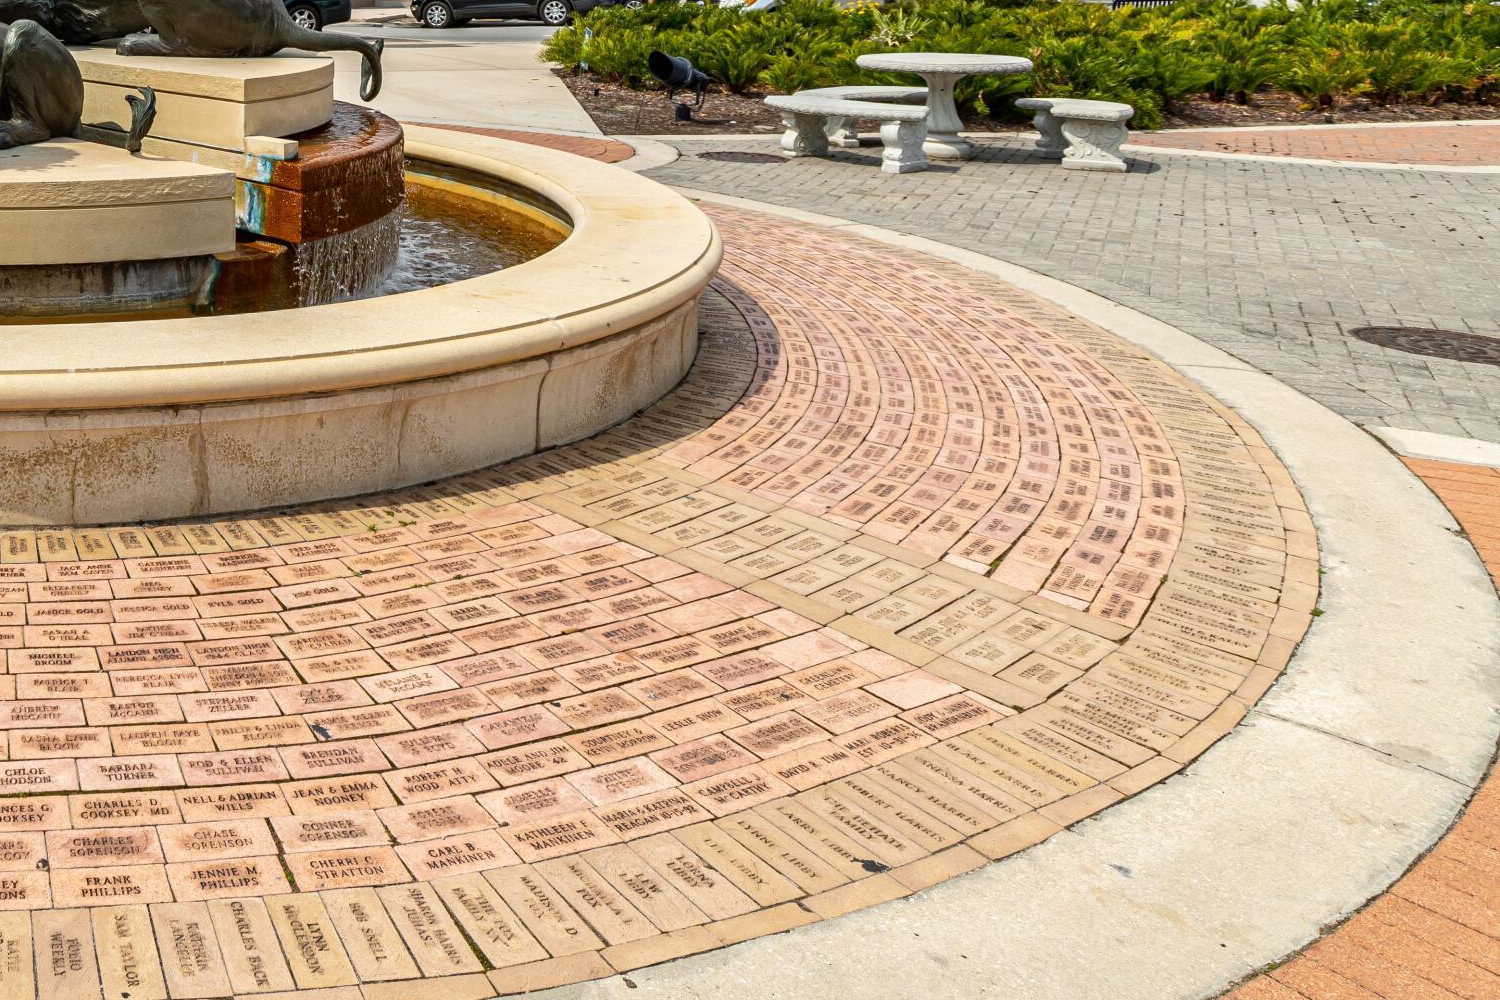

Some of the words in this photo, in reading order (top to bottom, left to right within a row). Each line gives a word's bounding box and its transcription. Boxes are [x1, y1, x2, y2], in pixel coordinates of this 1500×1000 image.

[662, 717, 697, 732] LESLIE
[696, 708, 724, 722] SNOW
[4, 767, 45, 777] CHLOE
[101, 762, 156, 773] BARBARA
[778, 763, 809, 779] DAVID
[820, 751, 850, 765] TIMM
[946, 742, 987, 767] BLAKE
[992, 768, 1045, 798] HARRIS
[0, 775, 51, 786] HODSON
[105, 771, 156, 781] TURNER
[292, 786, 324, 799] JEAN
[328, 785, 337, 794] &
[340, 781, 379, 794] EMMA
[182, 794, 216, 805] NELL
[218, 794, 227, 803] &
[229, 790, 277, 802] ADRIAN
[314, 792, 366, 806] NOONEY
[215, 802, 254, 812] WILLS
[844, 780, 893, 810] ROBERT
[896, 812, 946, 844] HARRIS
[194, 828, 238, 840] CHASE
[514, 821, 578, 844] KATHLEEN
[184, 837, 253, 851] SORENSON
[529, 829, 595, 851] MANKINEN
[428, 844, 462, 859] CARL
[309, 856, 360, 869] CHERRI
[425, 850, 496, 872] MANKINEN
[190, 867, 240, 881] JENNIE
[314, 866, 385, 881] STRATTON
[86, 876, 131, 886] FRANK
[200, 877, 259, 891] PHILLIPS
[81, 885, 141, 897] PHILLIPS
[230, 901, 254, 951] CHARLES
[250, 955, 271, 988] BACK
[119, 943, 140, 988] TAYLOR
